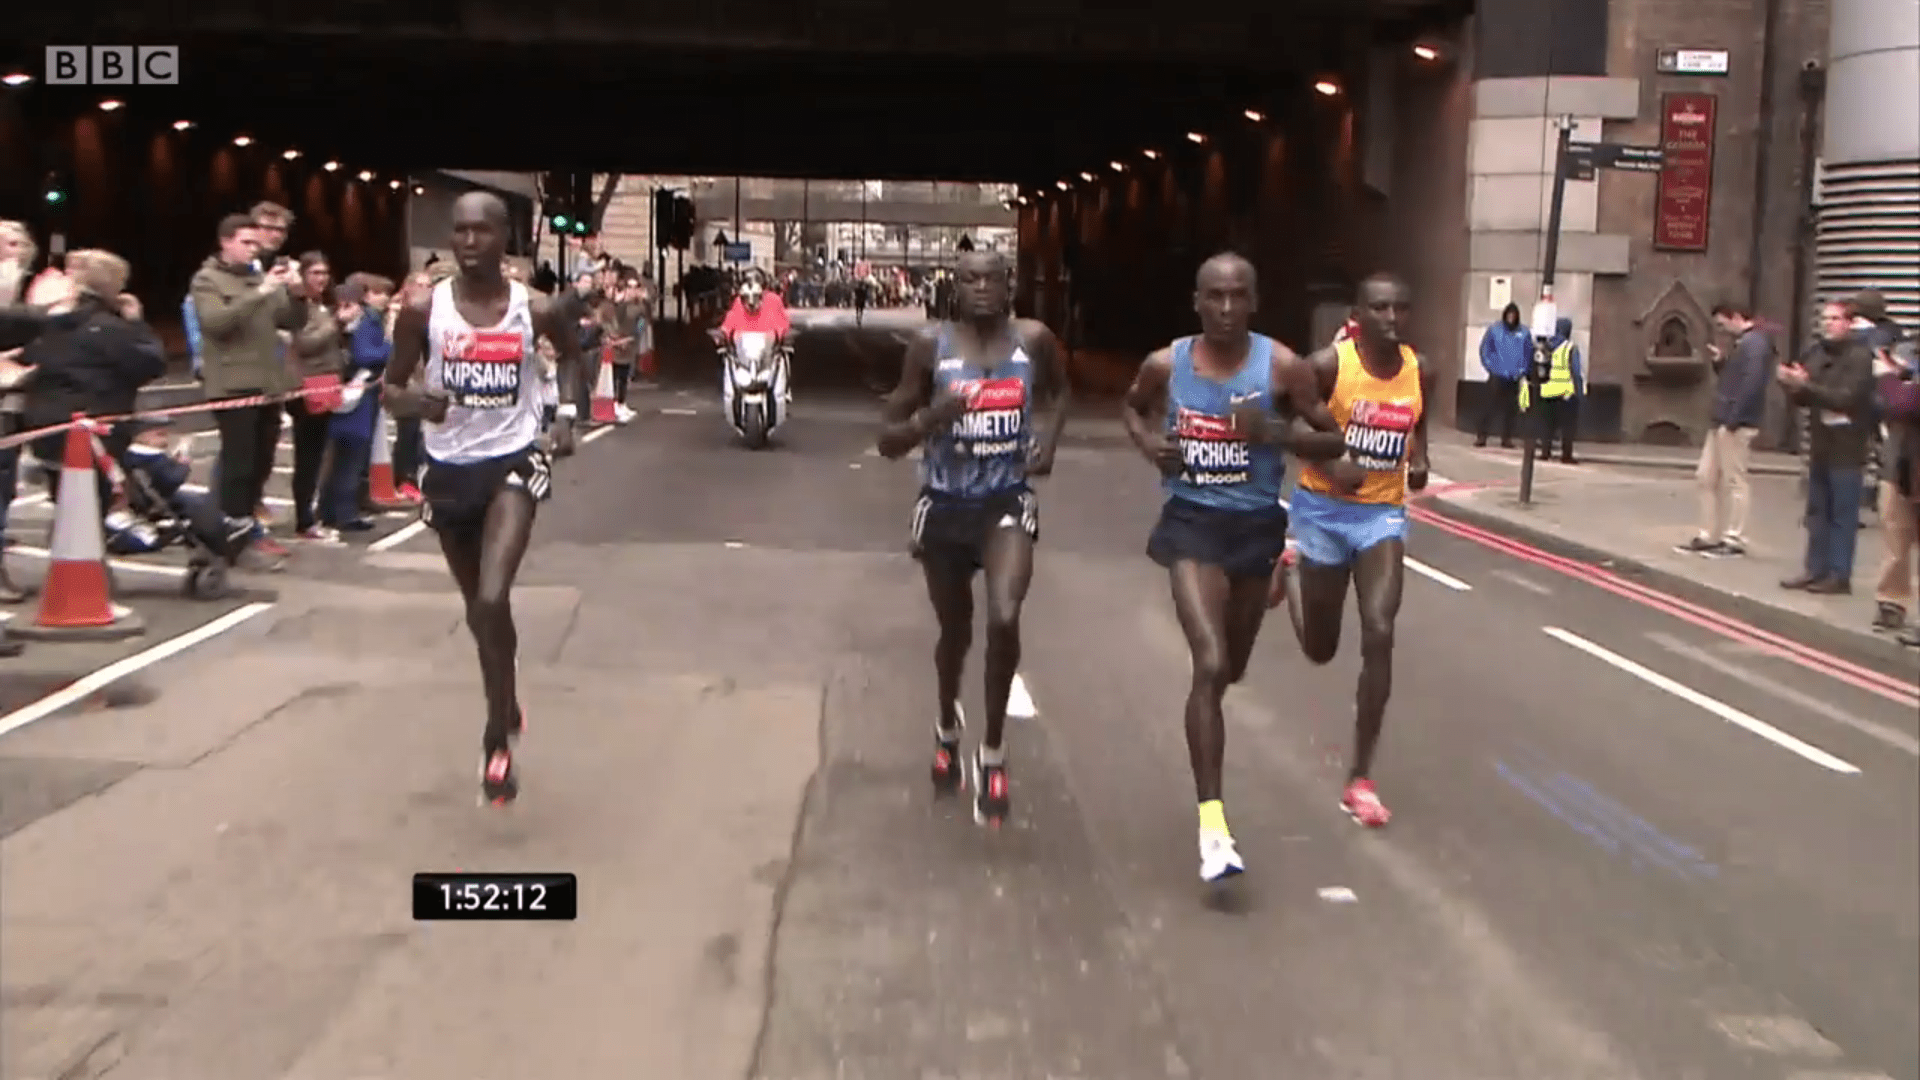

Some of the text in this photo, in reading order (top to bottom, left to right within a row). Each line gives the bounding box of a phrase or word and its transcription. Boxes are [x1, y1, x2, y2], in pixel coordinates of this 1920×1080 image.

[443, 361, 518, 390] KIPSANG
[463, 394, 513, 407] #boost
[972, 440, 1018, 456] #boost
[1344, 424, 1405, 456] BIWOTT
[1195, 472, 1248, 485] #boost
